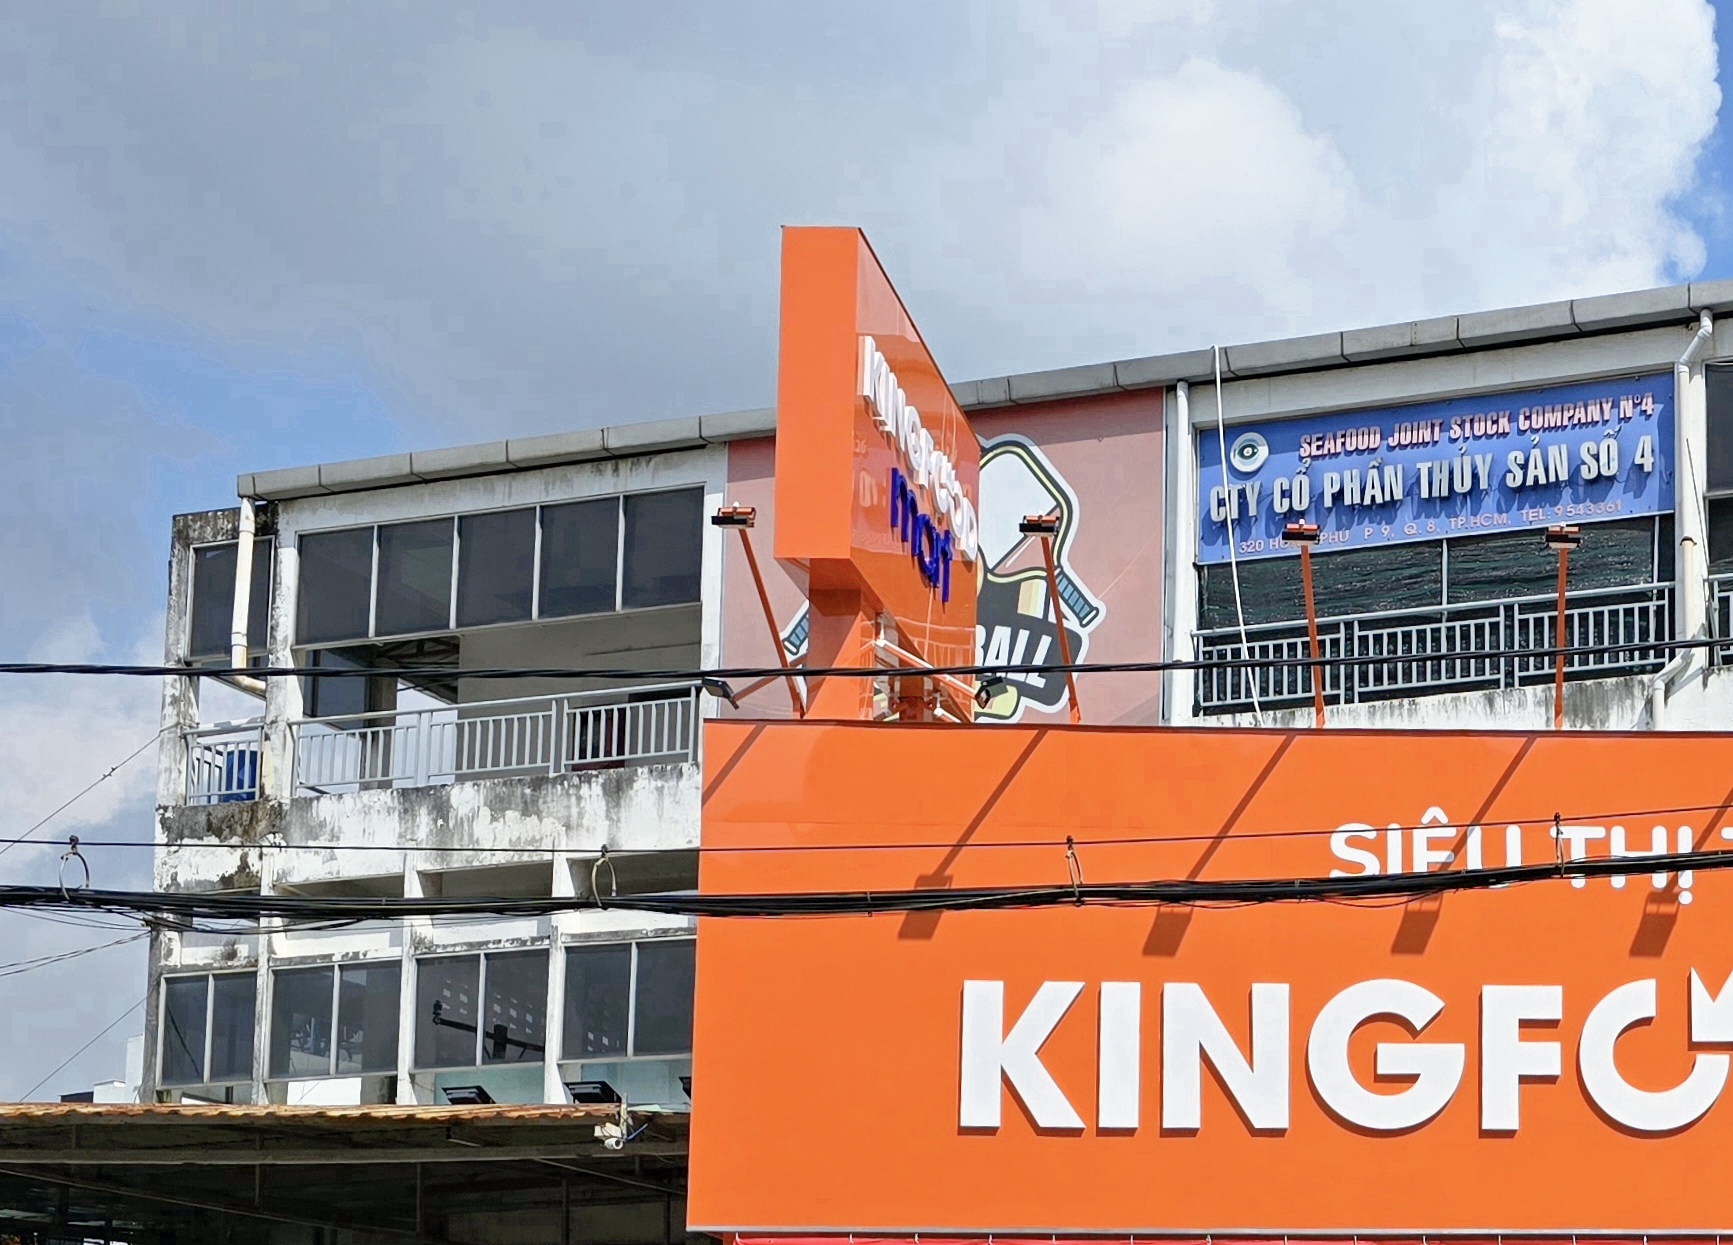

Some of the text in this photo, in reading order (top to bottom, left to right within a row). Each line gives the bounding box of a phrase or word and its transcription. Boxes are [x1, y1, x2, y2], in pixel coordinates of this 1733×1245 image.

[1300, 397, 1614, 457] SEAFOOD JOINT STOCK COMPANY
[1209, 480, 1263, 523] CTY
[1273, 457, 1312, 514] CỔ
[1416, 446, 1493, 499] THỦY
[1505, 435, 1569, 488] SẢN
[1580, 425, 1623, 481] SỐ
[1634, 435, 1655, 473] 4
[1239, 539, 1264, 554] 320
[1329, 806, 1522, 889] SIÊU
[1550, 825, 1693, 905] THỊ
